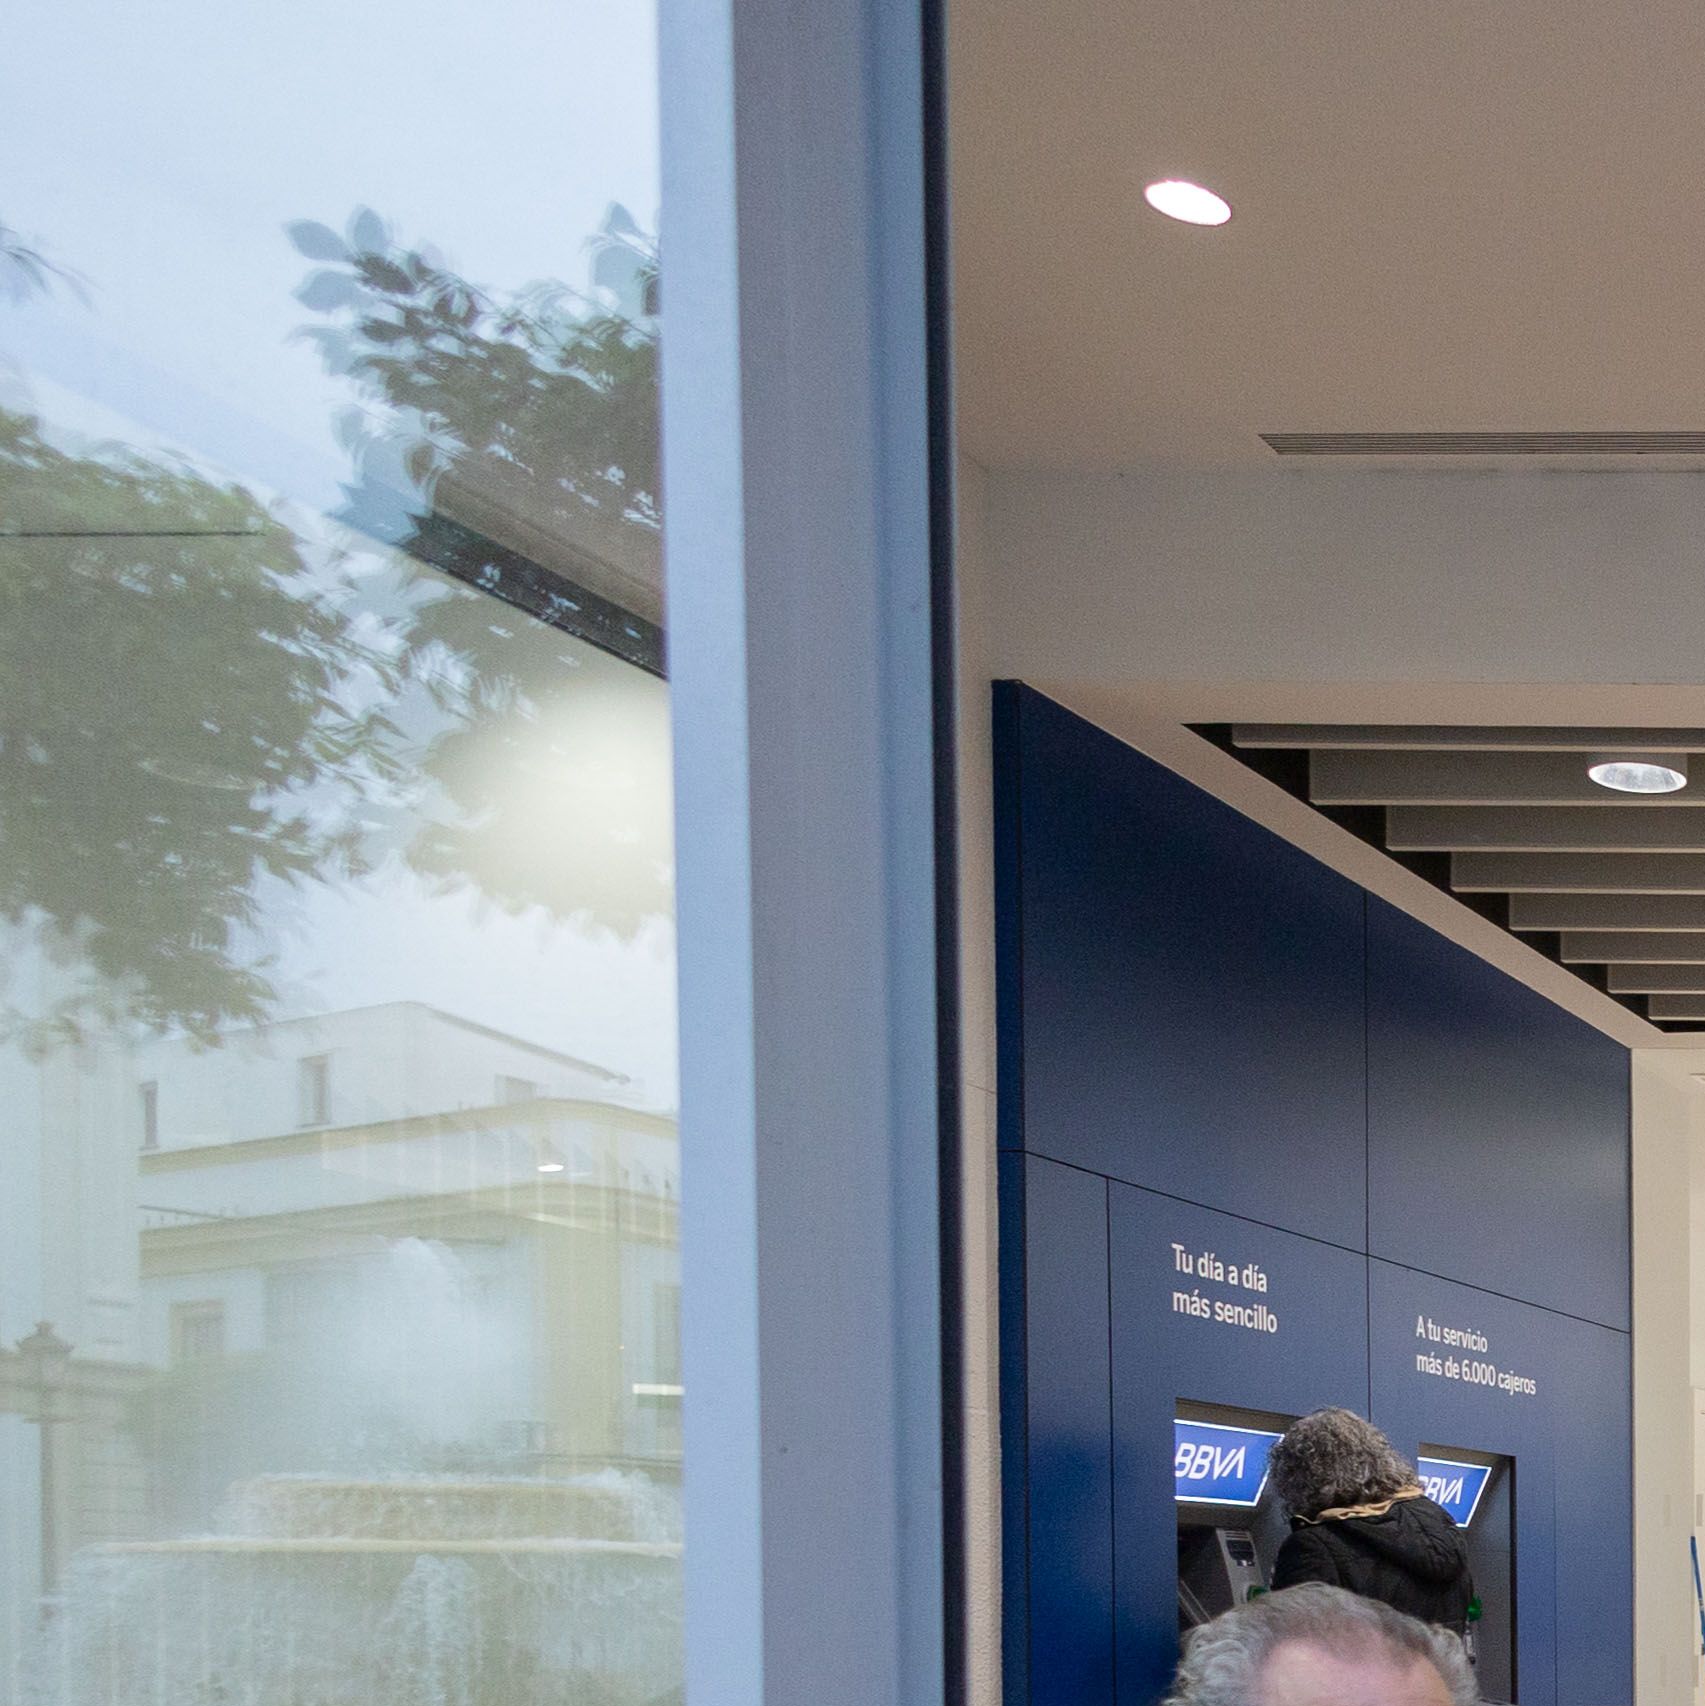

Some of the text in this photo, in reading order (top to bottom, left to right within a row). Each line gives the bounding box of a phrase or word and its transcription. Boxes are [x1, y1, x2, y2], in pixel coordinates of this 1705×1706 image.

[1171, 1242, 1268, 1293] Tu día a día
[1172, 1288, 1278, 1334] más sencillo
[1416, 1315, 1488, 1353] A tu servicio
[1416, 1351, 1537, 1396] más de 6.000 cajeros
[1174, 1442, 1246, 1481] BBVA
